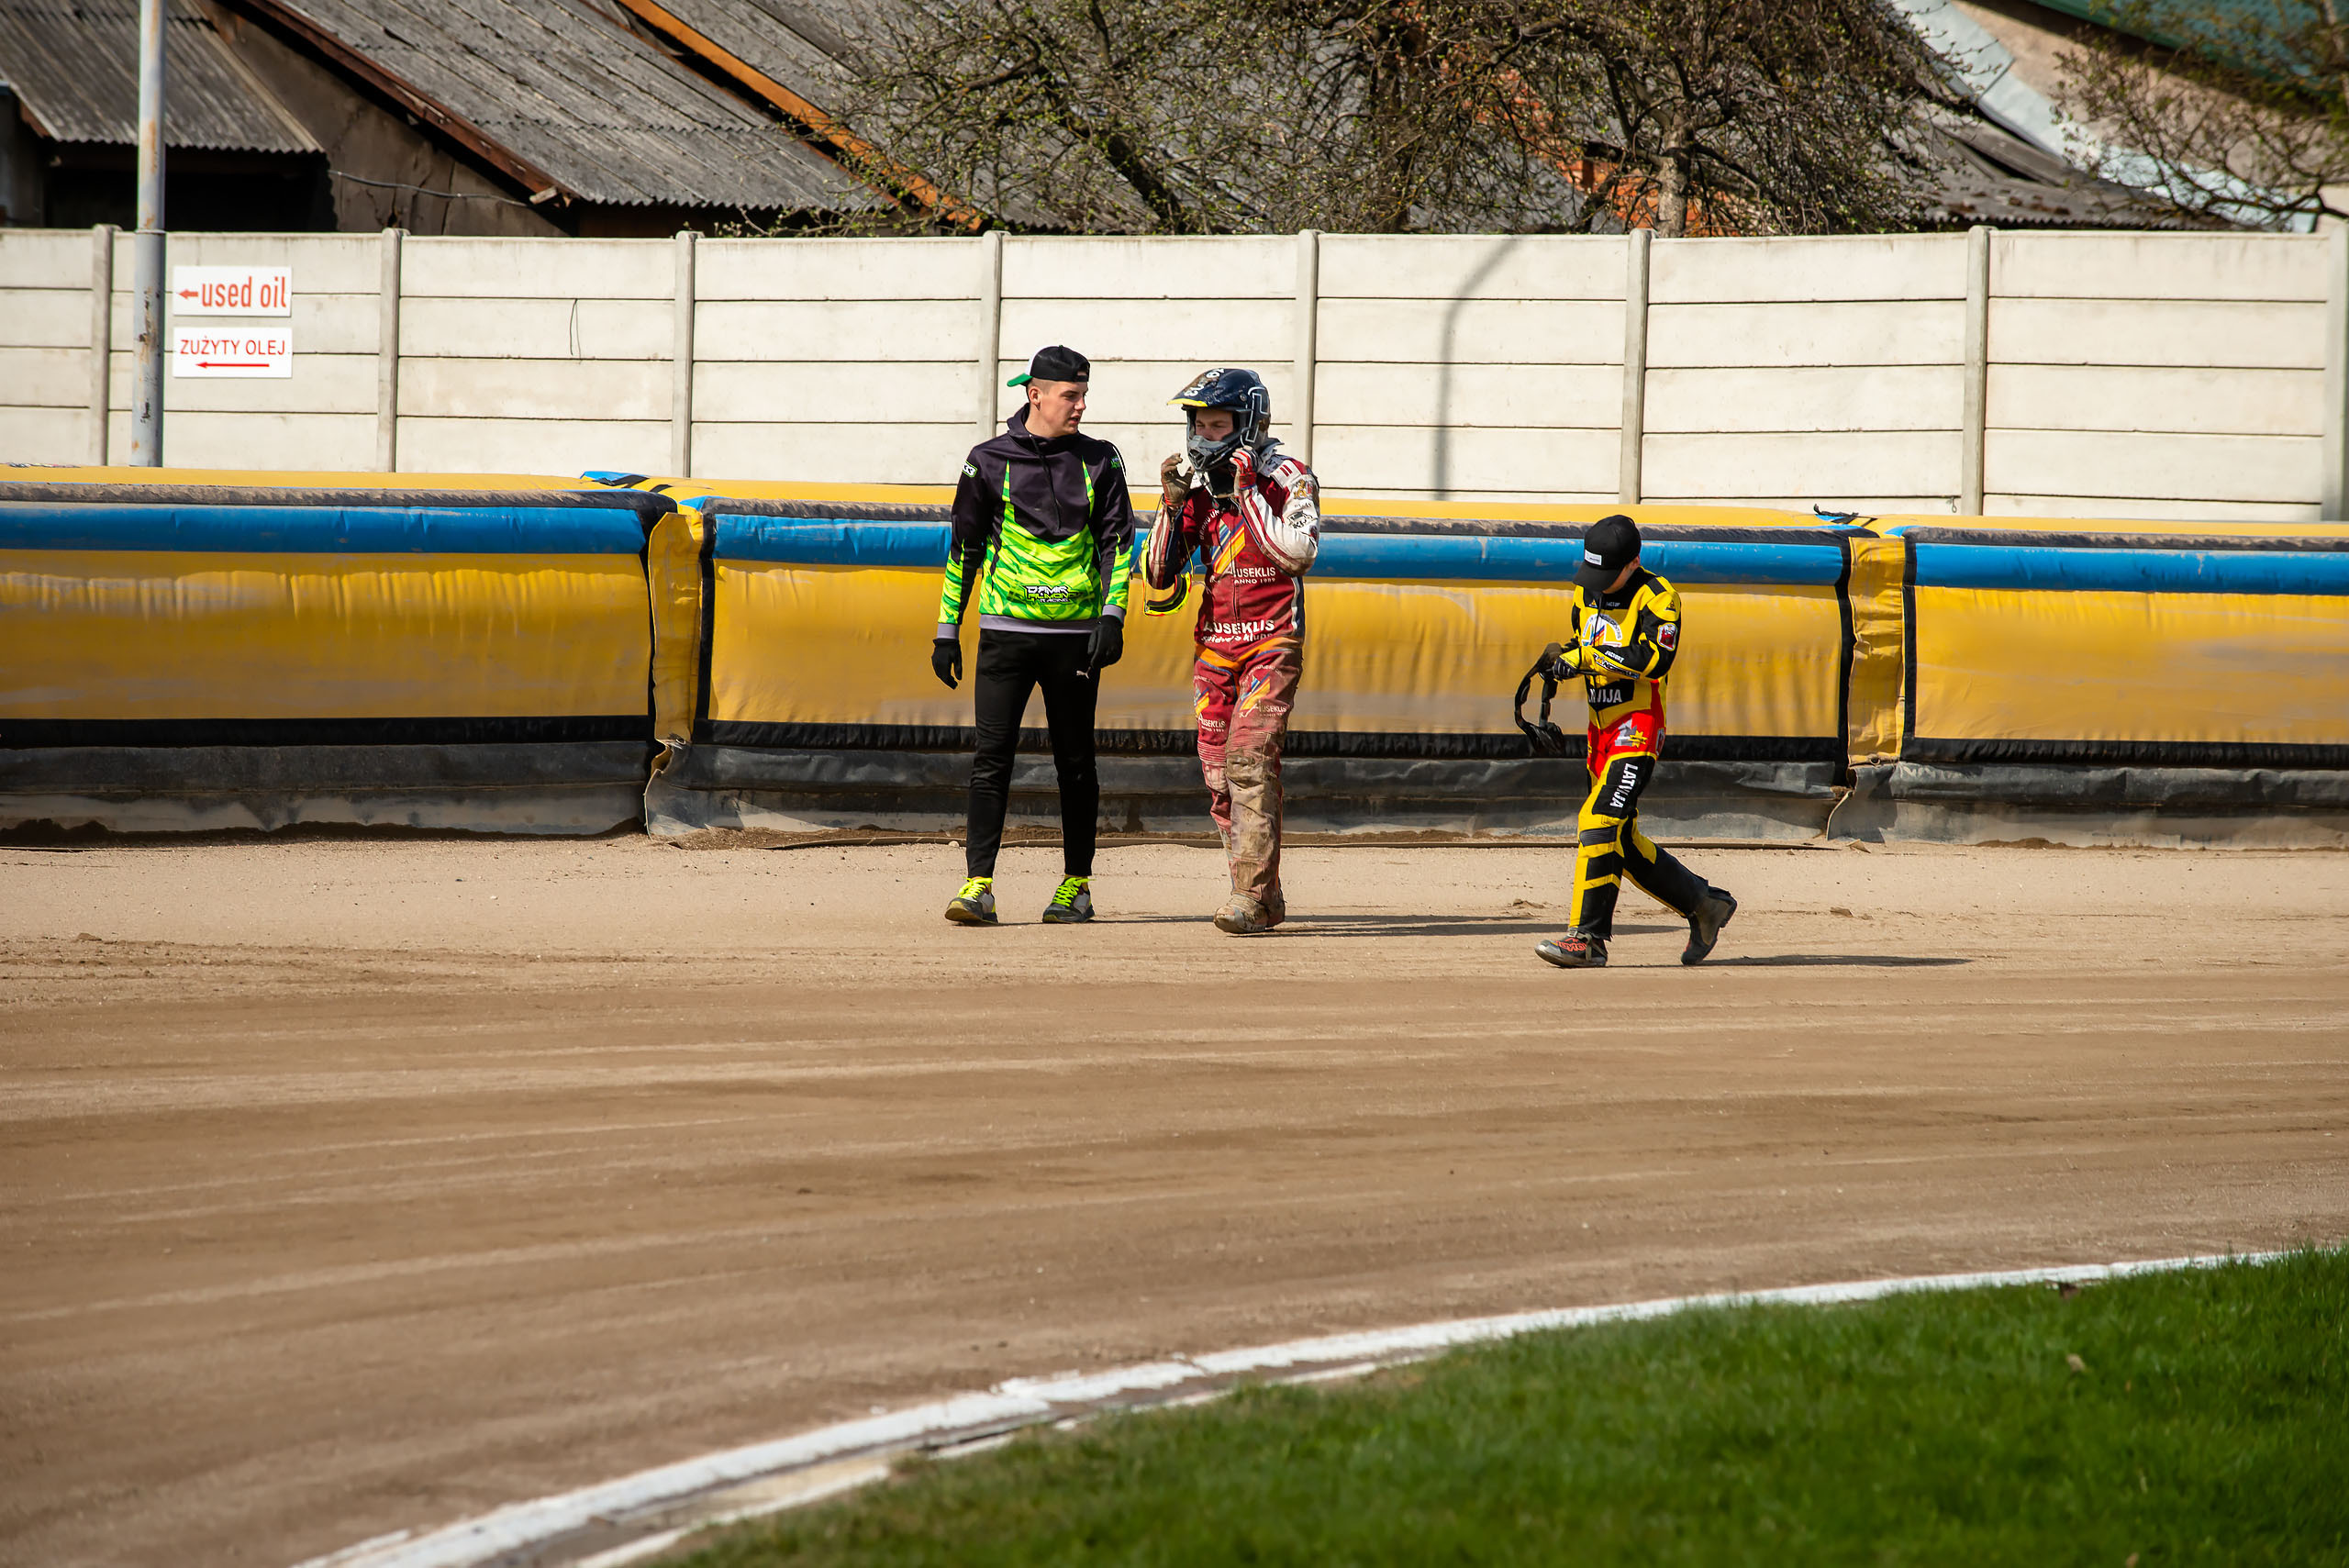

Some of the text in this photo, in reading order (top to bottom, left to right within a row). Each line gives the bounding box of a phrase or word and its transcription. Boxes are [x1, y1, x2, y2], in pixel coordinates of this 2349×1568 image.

[202, 276, 286, 307] used oil
[180, 336, 285, 355] ZUŻYTY OLEJ
[1222, 560, 1276, 578] AUSEKLIS
[1203, 619, 1275, 635] AUSEKLIS
[1609, 762, 1639, 808] LATVIJA
